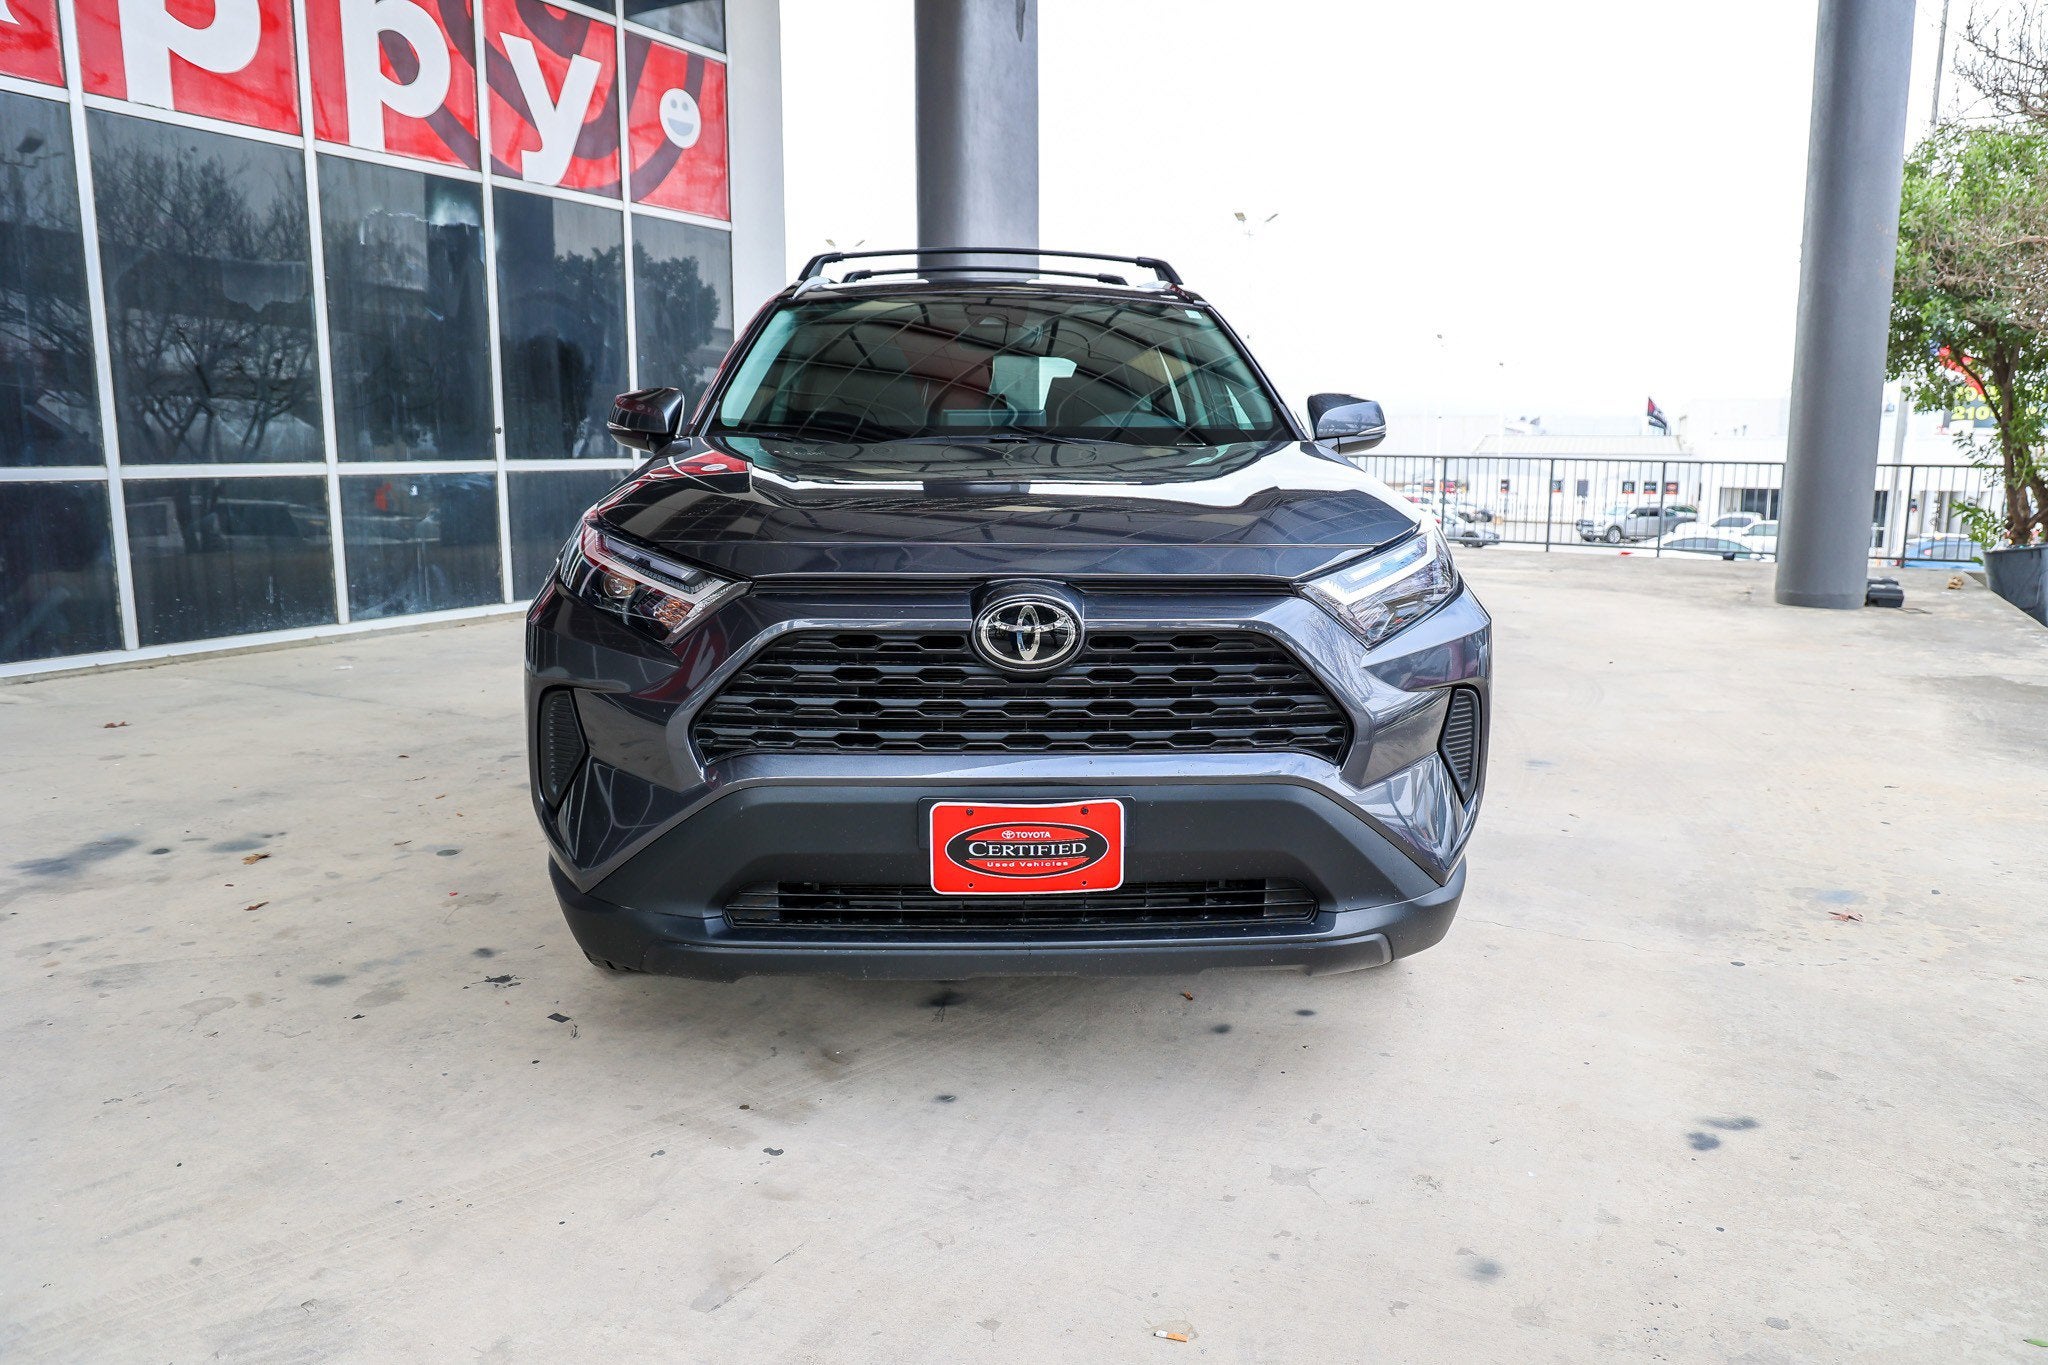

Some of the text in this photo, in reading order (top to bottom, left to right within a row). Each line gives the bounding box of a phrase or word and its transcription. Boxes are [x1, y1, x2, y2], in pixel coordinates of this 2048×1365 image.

[1016, 831, 1051, 839] TOYOTA
[968, 841, 1087, 857] CERTIFIED
[1019, 860, 1069, 868] Vehicles
